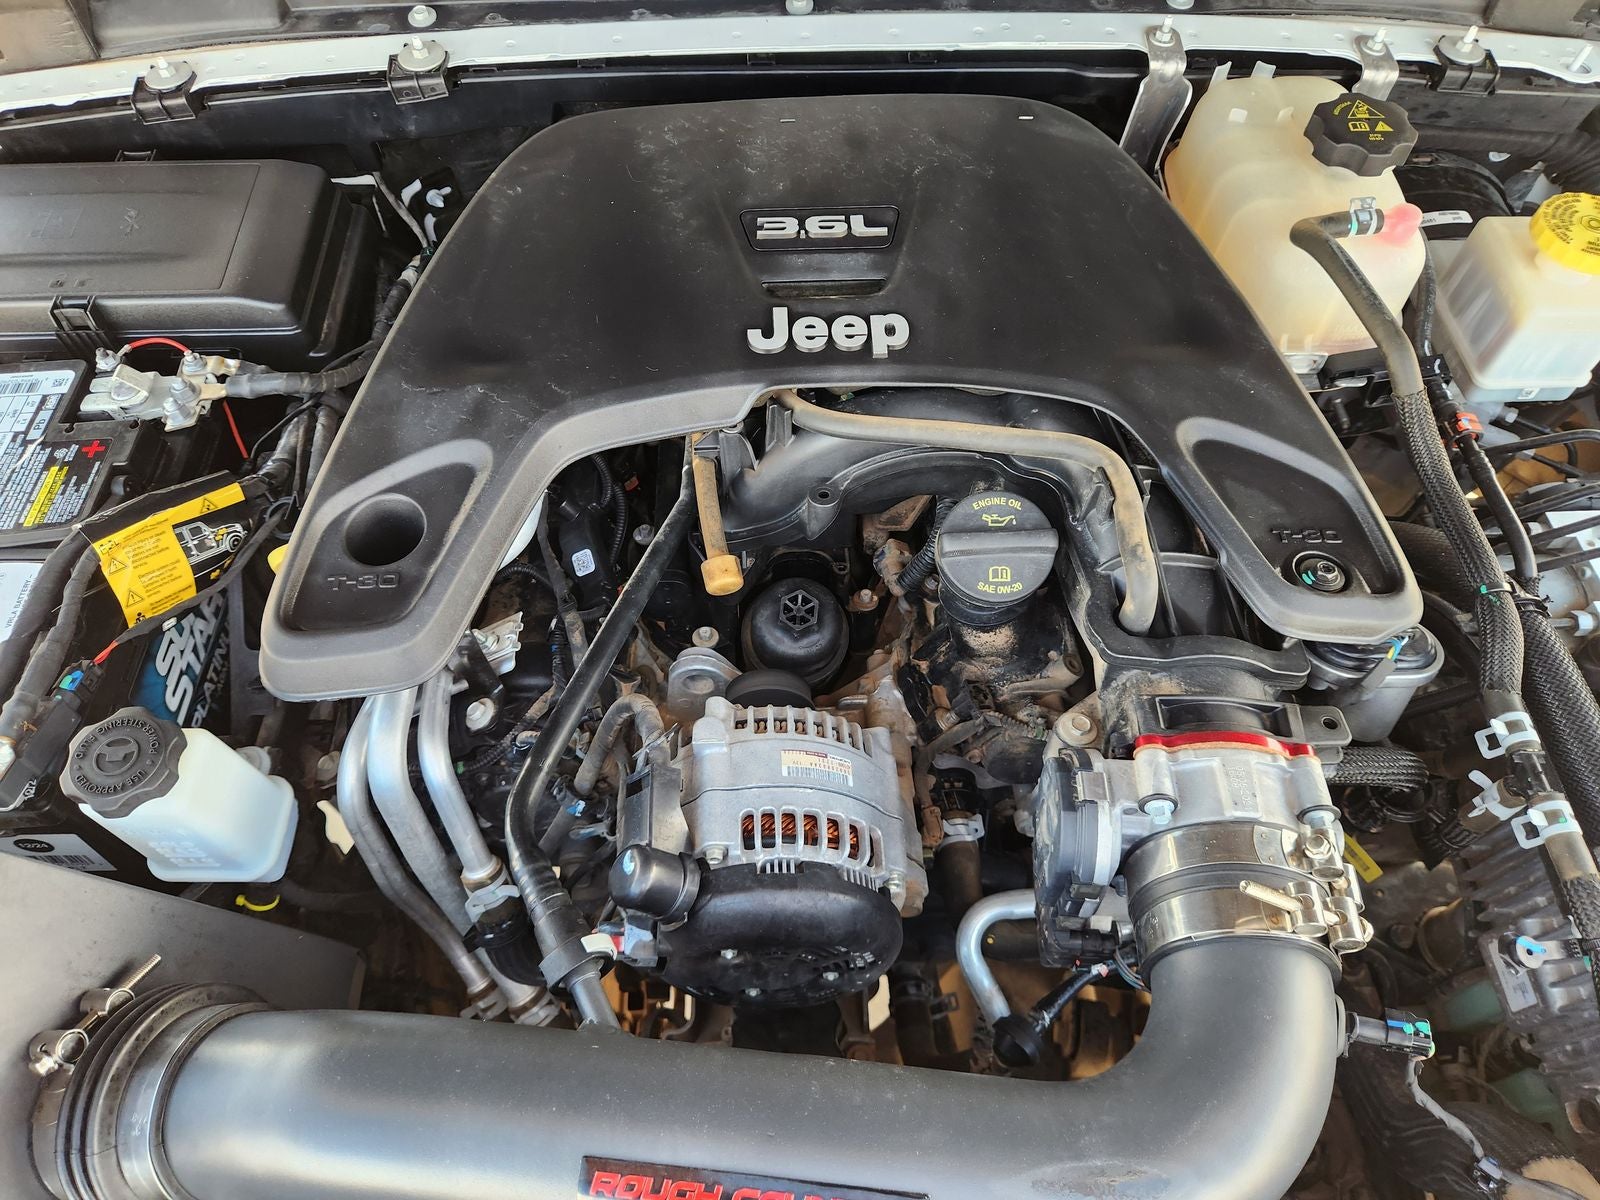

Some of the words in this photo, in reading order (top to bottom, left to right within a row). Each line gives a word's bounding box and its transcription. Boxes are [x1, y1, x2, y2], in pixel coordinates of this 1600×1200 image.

[756, 214, 889, 240] 3.6L
[747, 306, 910, 359] Jeep
[972, 497, 1007, 511] ENGINE
[1008, 499, 1023, 511] OIL
[327, 574, 398, 591] T-30
[977, 581, 997, 594] SAE
[997, 582, 1023, 594] 0W-20
[97, 718, 145, 734] STEERING
[142, 723, 160, 754] POWER
[75, 774, 125, 794] APPROVED
[126, 768, 147, 786] USE
